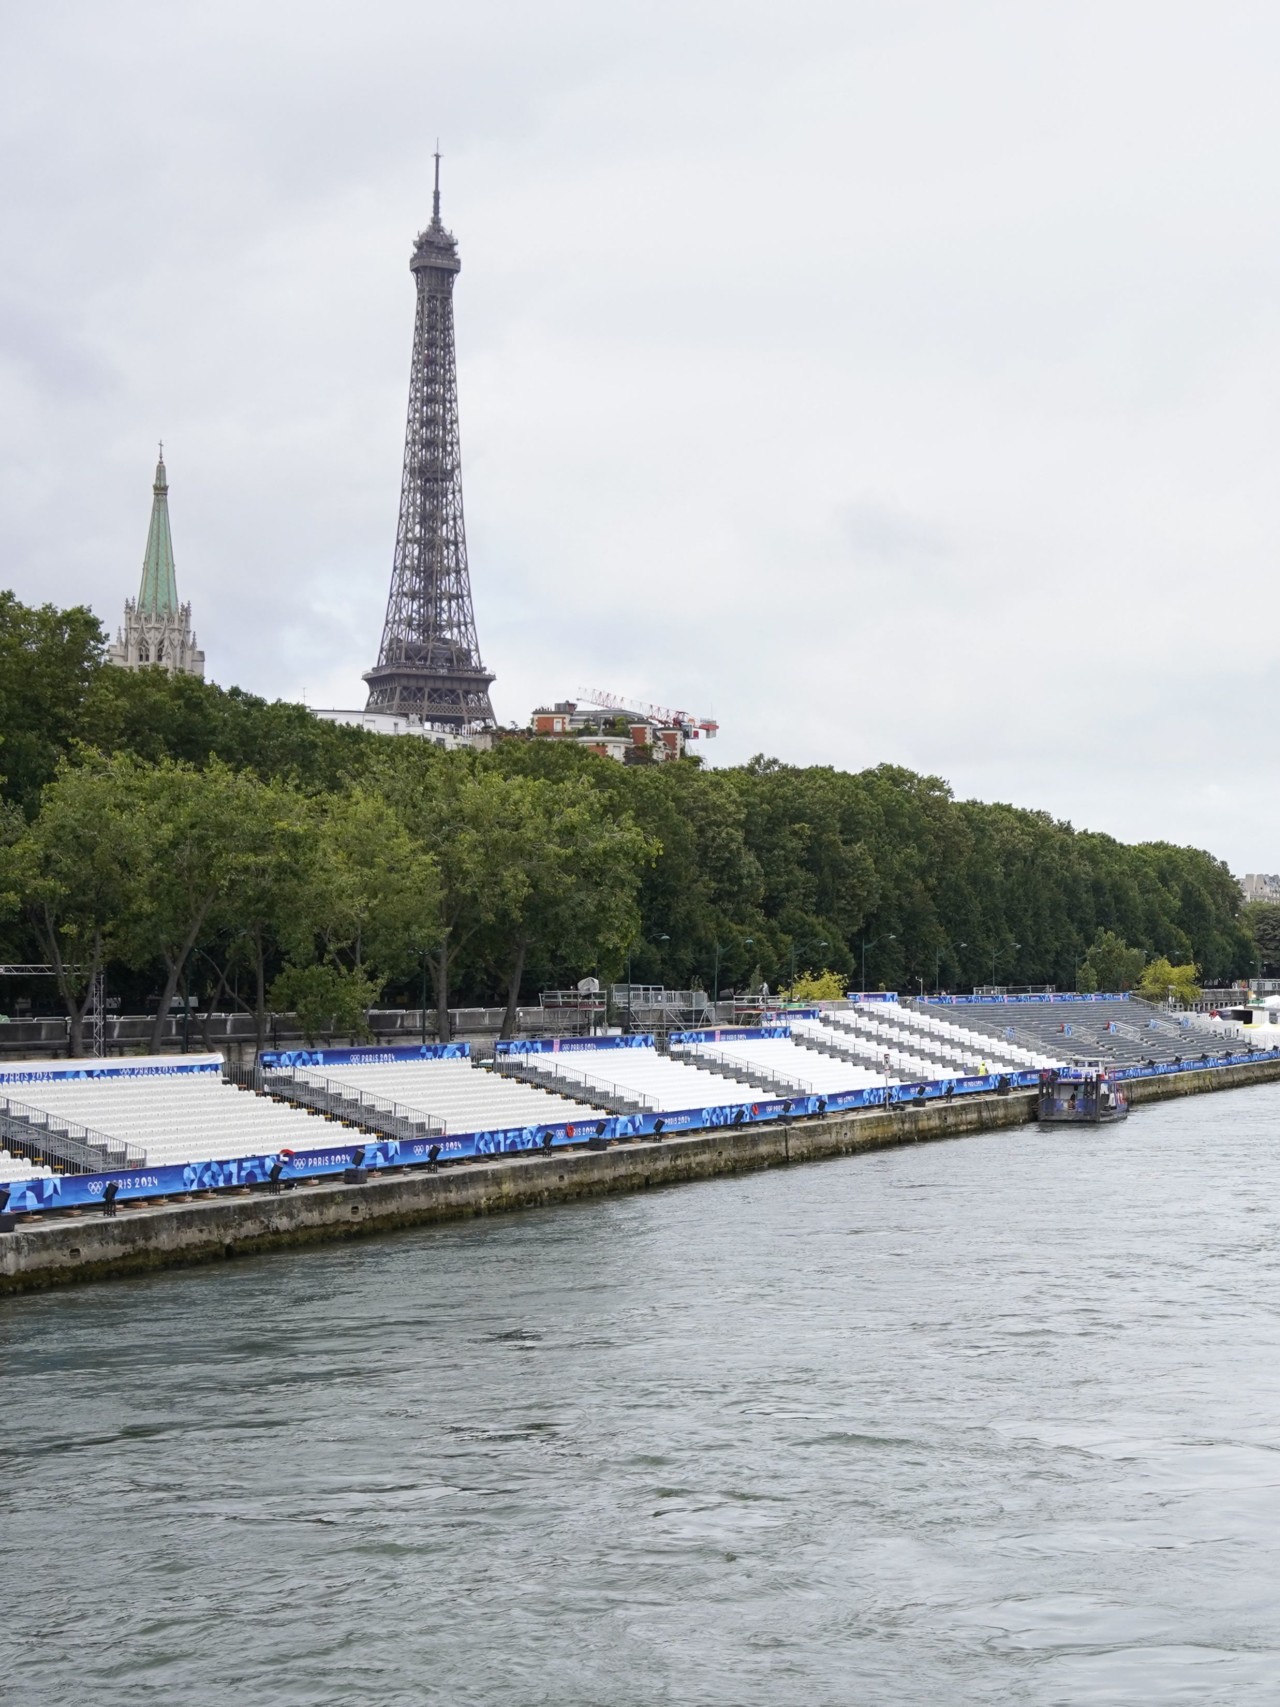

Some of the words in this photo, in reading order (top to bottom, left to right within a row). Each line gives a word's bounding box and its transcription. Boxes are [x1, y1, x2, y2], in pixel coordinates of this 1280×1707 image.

[361, 1054, 379, 1062] PARIS
[380, 1053, 395, 1061] 2024
[134, 1066, 156, 1076] PARIS
[4, 1072, 29, 1082] PARIS
[31, 1072, 54, 1081] 2024
[445, 1141, 462, 1151] 2024
[308, 1156, 329, 1167] PARIS
[331, 1154, 350, 1165] 2024
[135, 1176, 158, 1189] 2024
